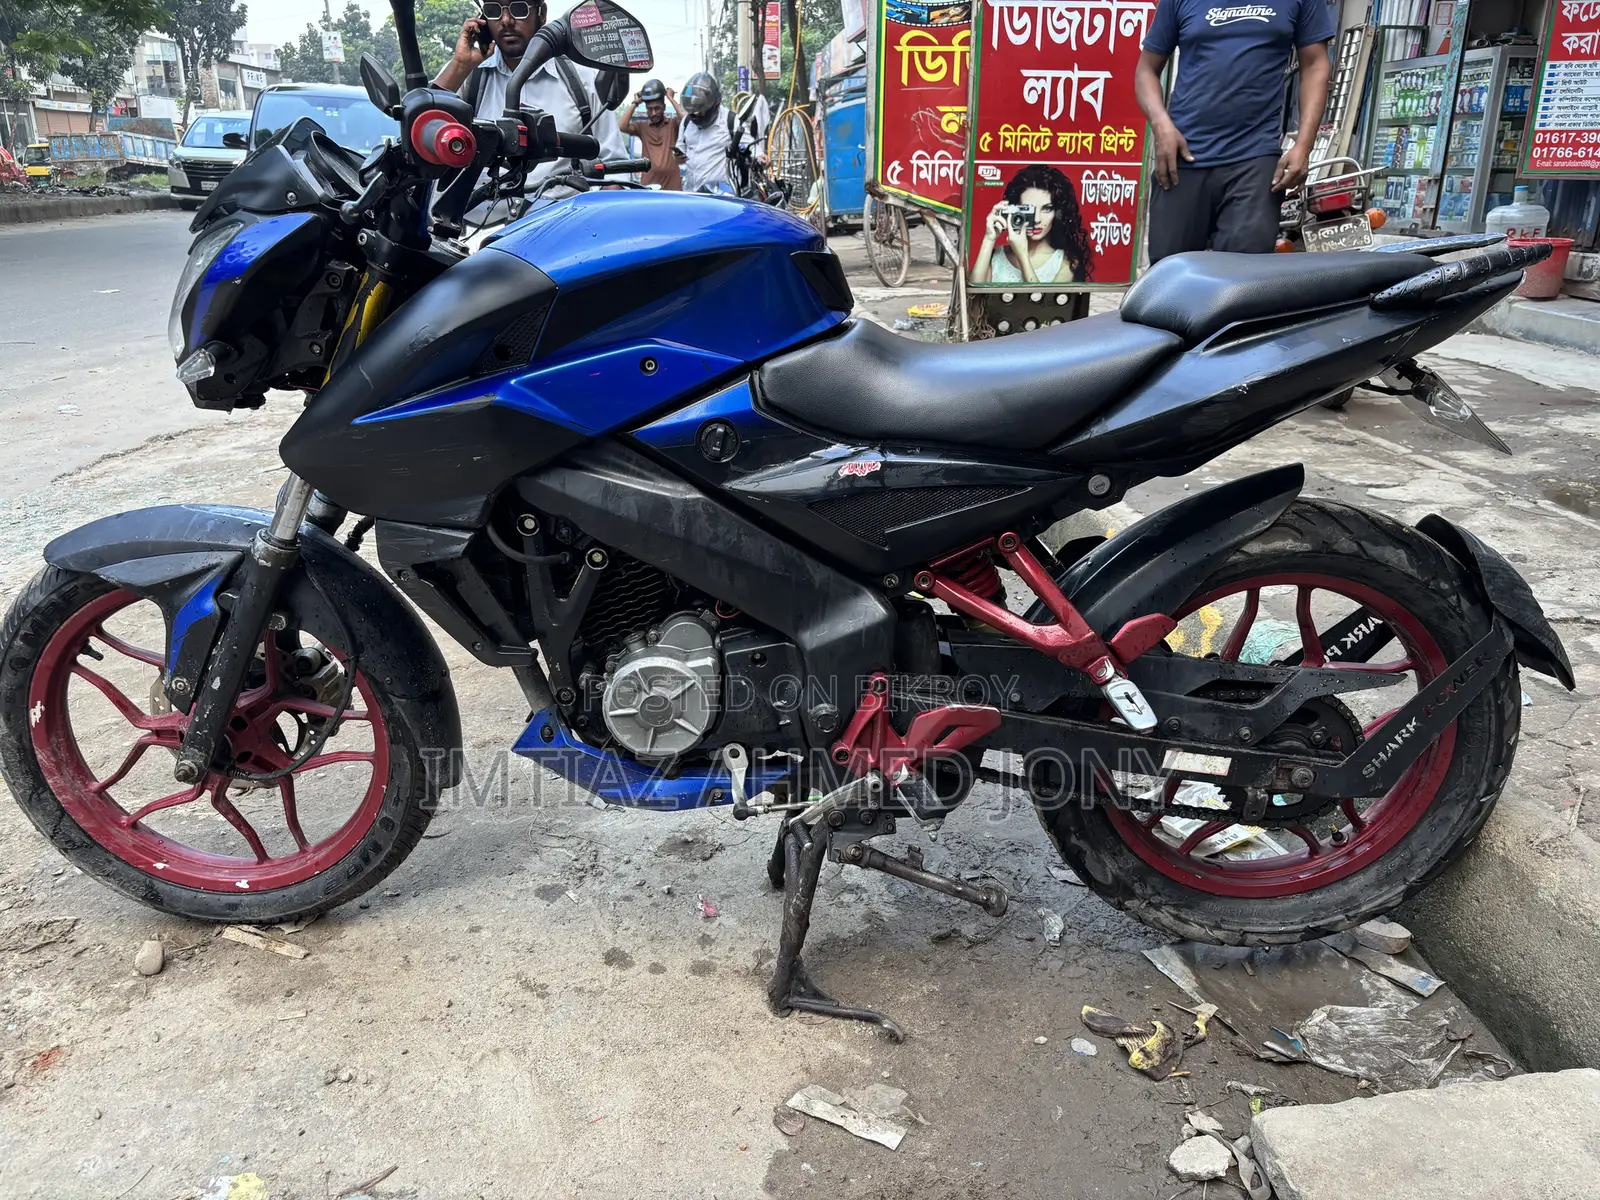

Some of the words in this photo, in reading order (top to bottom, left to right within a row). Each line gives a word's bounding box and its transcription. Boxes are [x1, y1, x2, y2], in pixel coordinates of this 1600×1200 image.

[1205, 4, 1277, 26] Signature
[1019, 62, 1114, 123] ল্যাব
[979, 132, 994, 153] ৫
[998, 123, 1054, 154] মিনিটে
[1057, 129, 1096, 155] ল্যাব
[1099, 125, 1138, 156] প্রিন্ট
[886, 160, 904, 185] ৫
[1081, 169, 1138, 207] ডিজিটাল
[1090, 212, 1132, 256] স্টুডিও
[1362, 716, 1423, 779] SHARK
